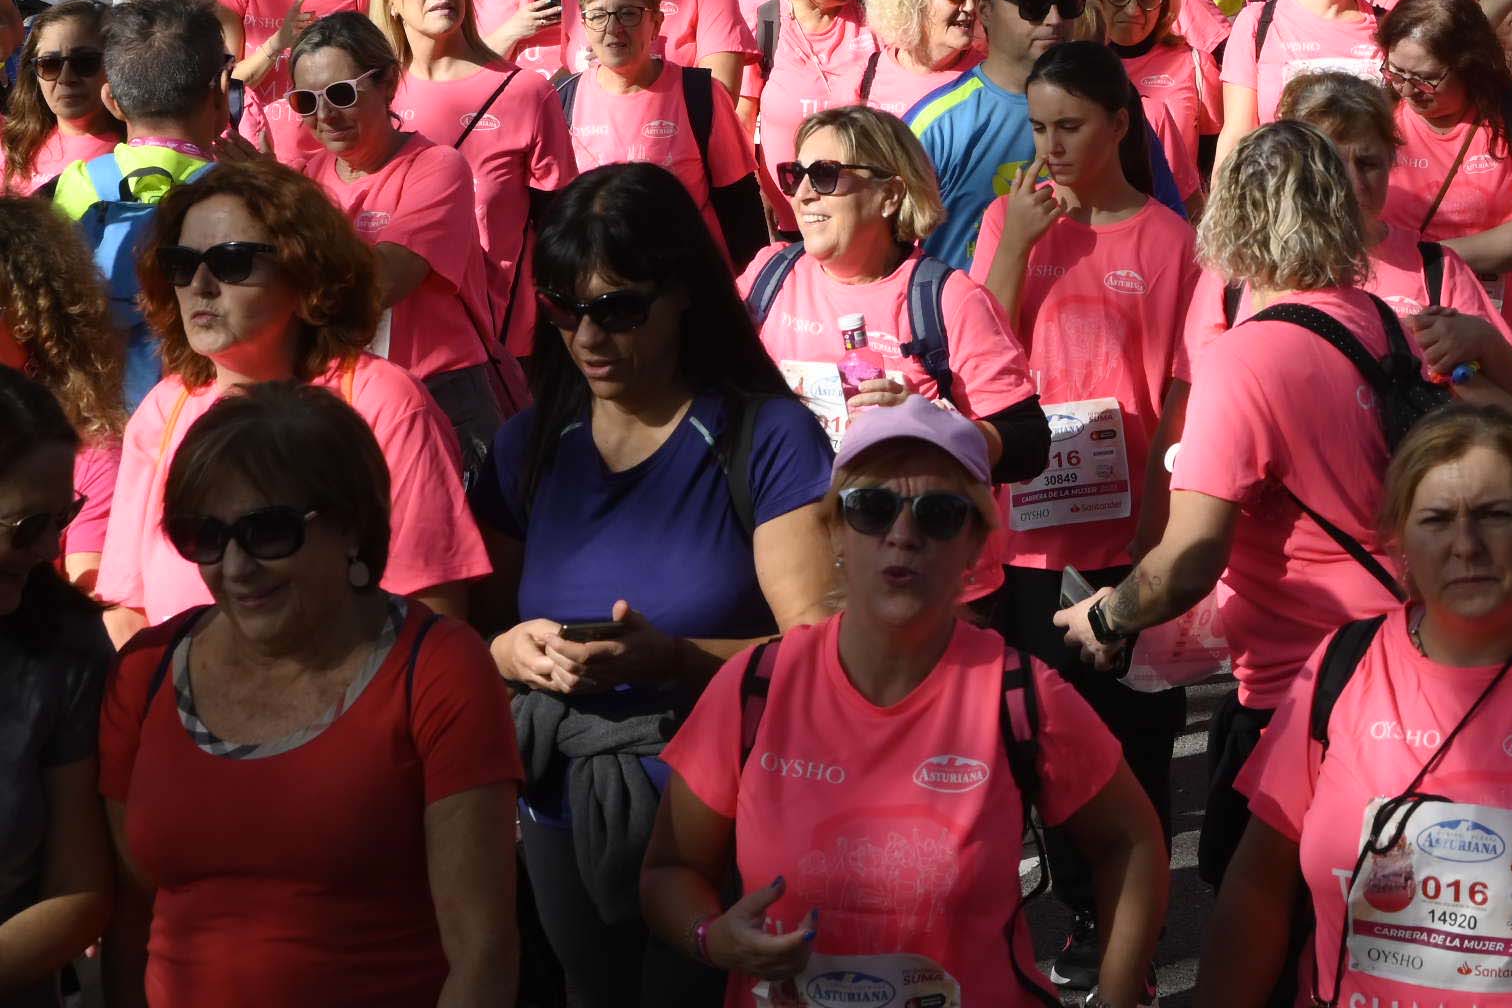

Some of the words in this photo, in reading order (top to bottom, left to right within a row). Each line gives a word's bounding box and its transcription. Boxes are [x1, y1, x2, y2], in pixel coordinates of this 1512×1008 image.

[1027, 265, 1065, 277] YSHO
[1052, 450, 1082, 468] 16
[1044, 473, 1078, 487] 30849
[760, 751, 846, 785] OYSHO
[919, 767, 984, 783] ASTURIANA
[1425, 833, 1498, 856] ASTURIANA
[1421, 875, 1489, 906] 016
[1427, 909, 1478, 930] 14920
[1374, 926, 1427, 942] CARRERA
[1429, 933, 1444, 945] DE
[1446, 936, 1460, 948] LA
[1464, 939, 1505, 952] MUJER
[1367, 947, 1424, 970] OYSHO
[904, 973, 944, 986] SUMA
[814, 983, 889, 1002] ASTURIANA
